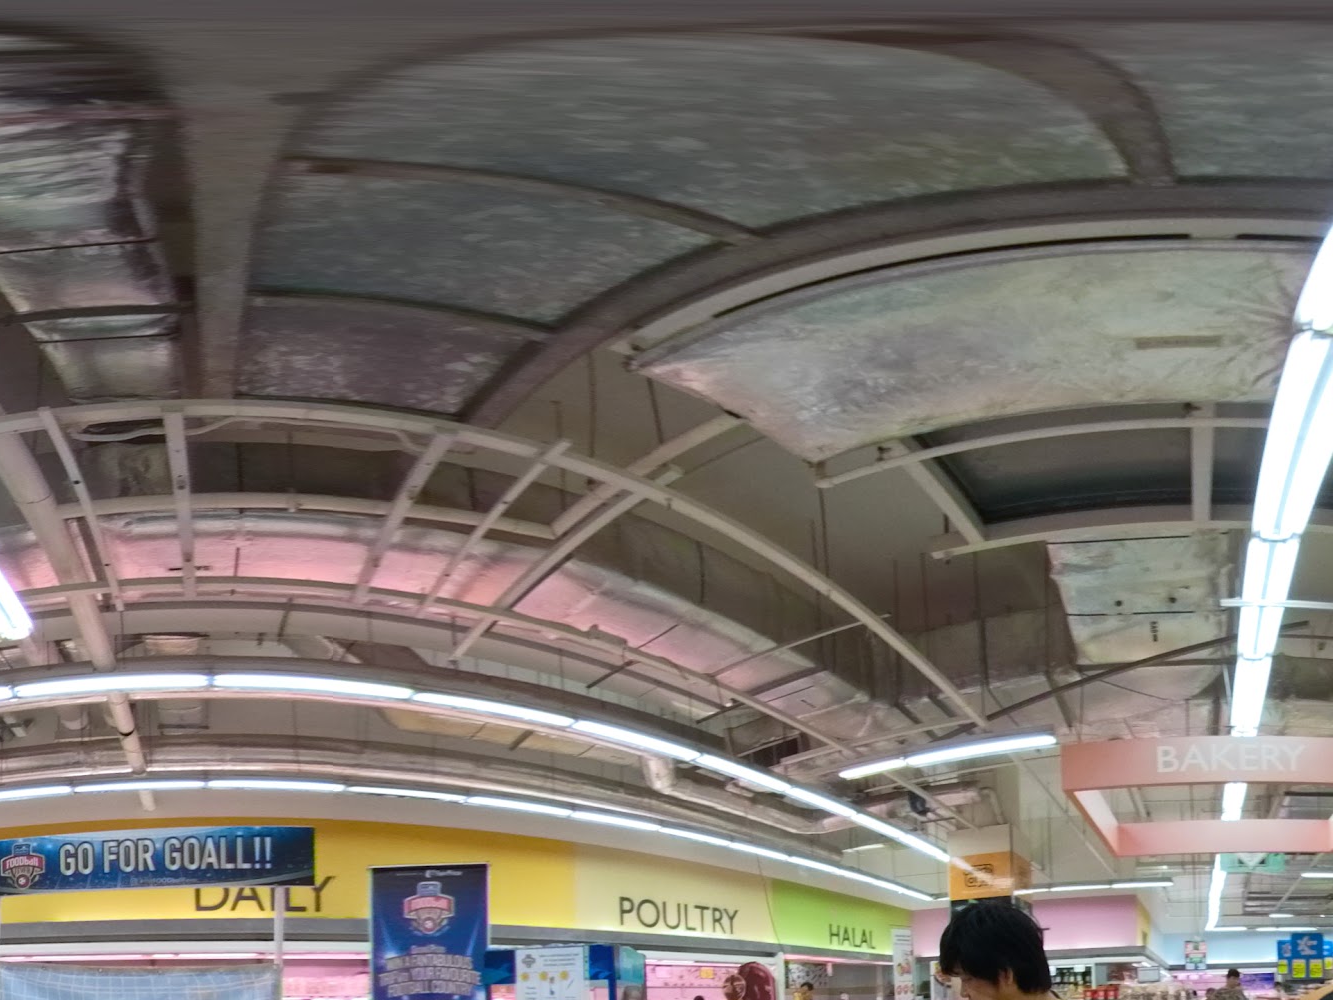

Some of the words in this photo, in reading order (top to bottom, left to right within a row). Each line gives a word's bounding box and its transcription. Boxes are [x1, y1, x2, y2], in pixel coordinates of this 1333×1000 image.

[1156, 744, 1306, 773] BAKERY
[60, 842, 94, 876] GO
[103, 838, 156, 874] FOR
[164, 836, 272, 871] GOALL!!
[619, 896, 739, 935] POULTRY
[829, 923, 876, 950] HALAL
